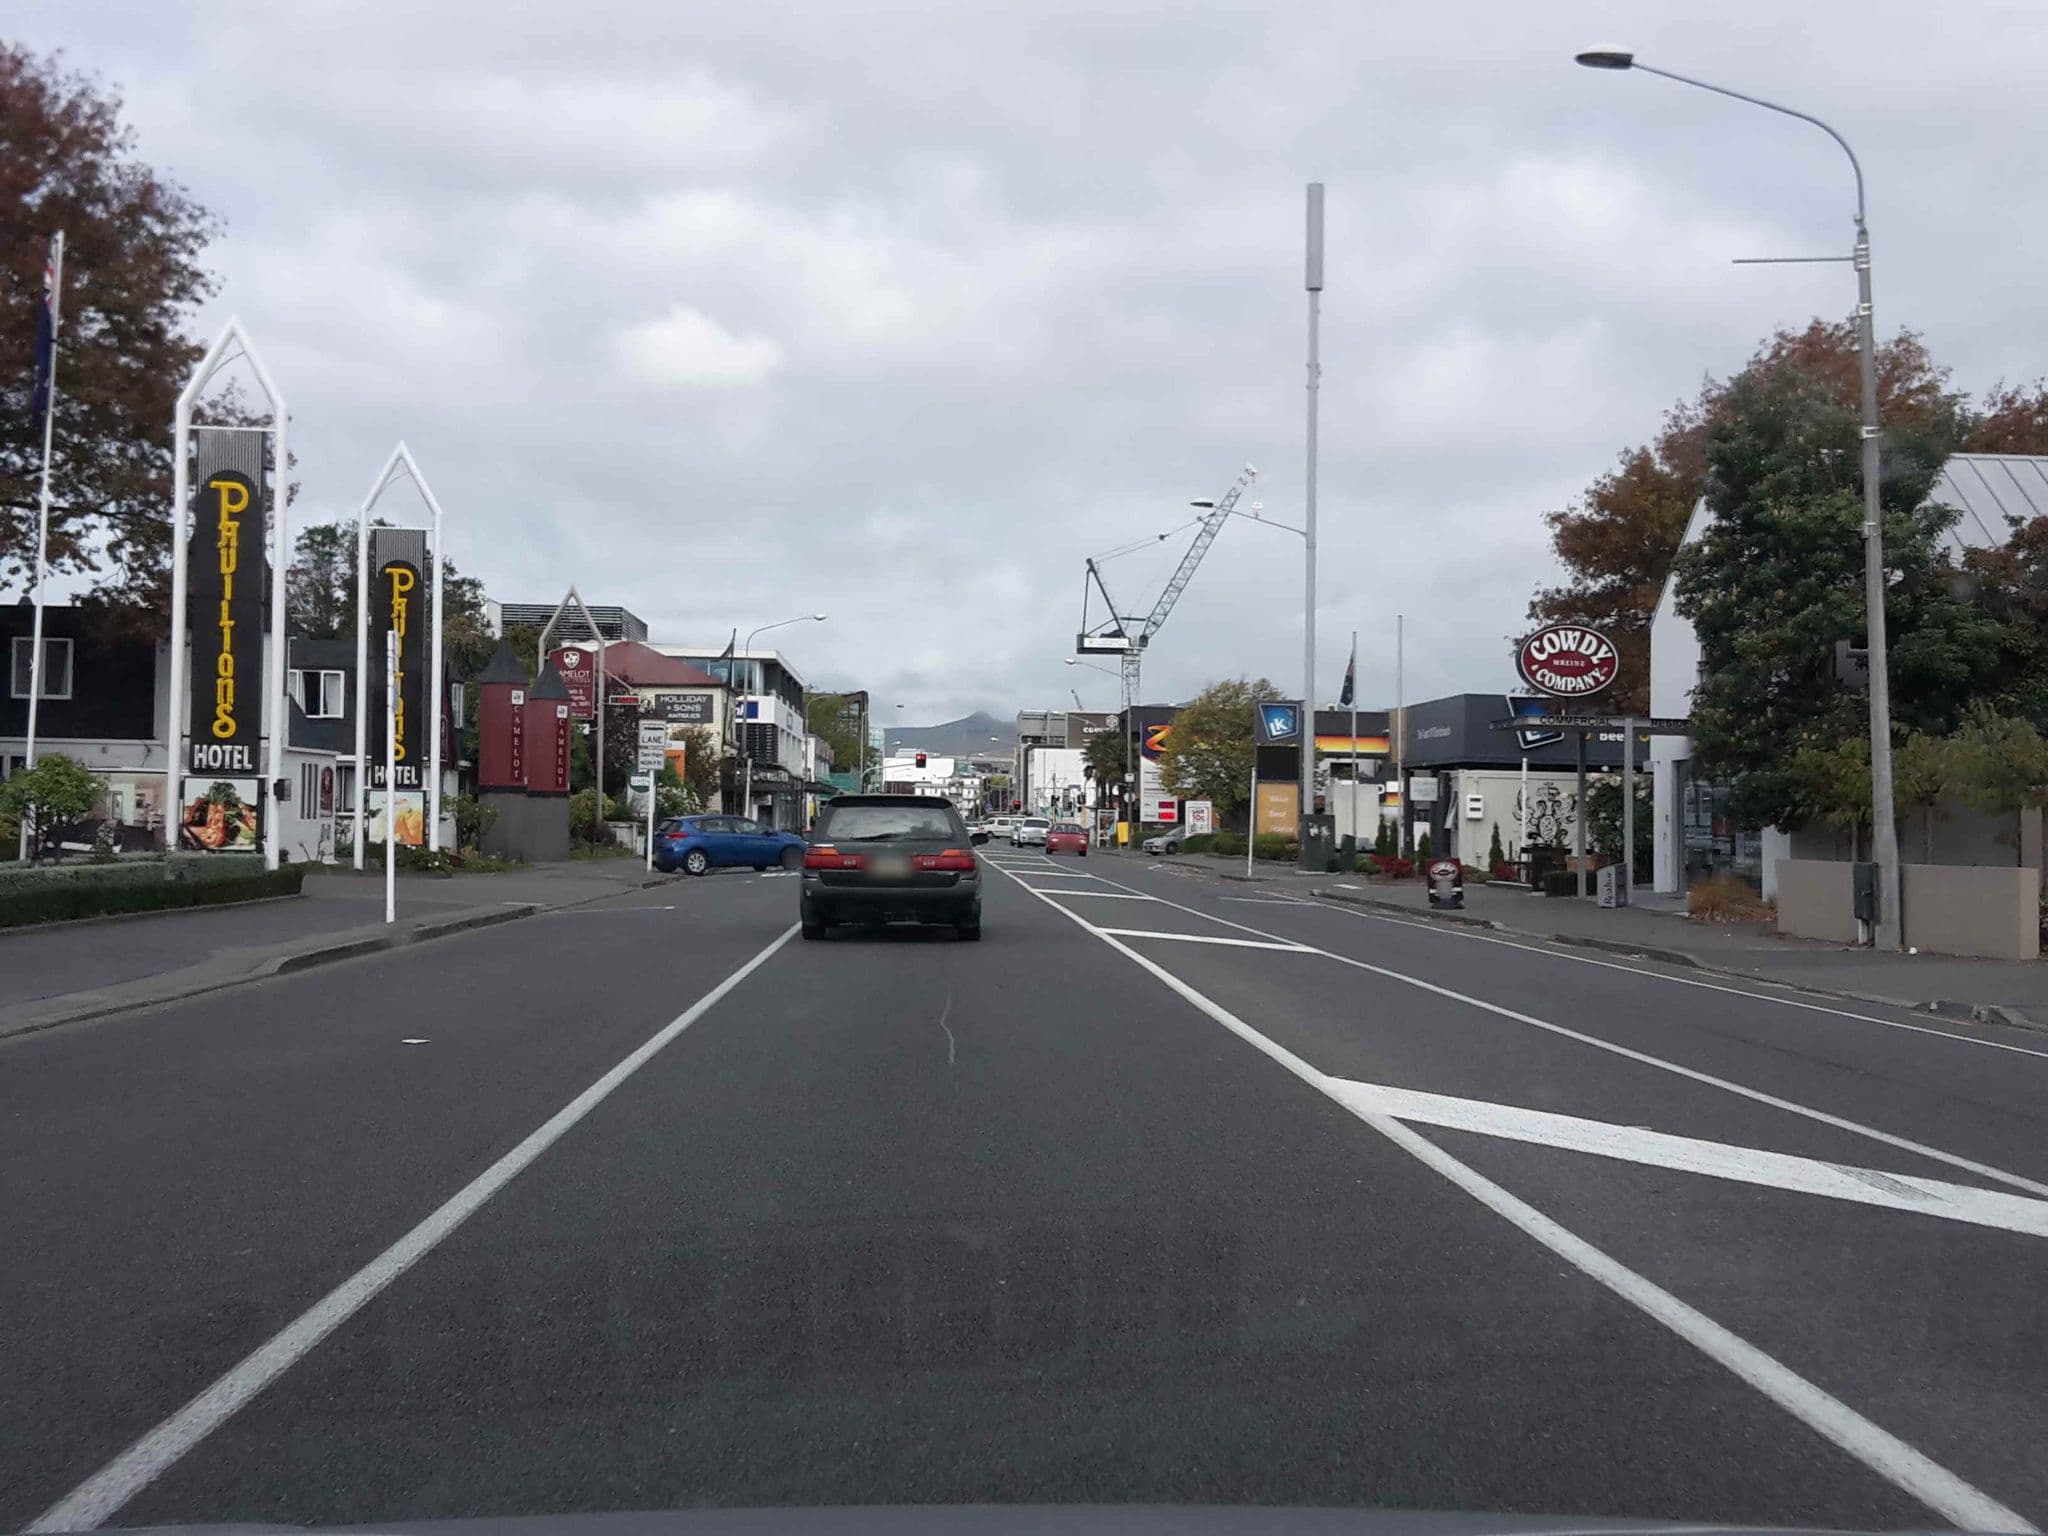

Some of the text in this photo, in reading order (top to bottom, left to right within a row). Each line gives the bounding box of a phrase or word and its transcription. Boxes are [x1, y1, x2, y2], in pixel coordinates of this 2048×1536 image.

[1530, 630, 1613, 664] COWDY
[559, 670, 591, 678] AMELOT
[1536, 667, 1605, 691] COMPANY
[660, 695, 707, 703] HOLLIDAY
[1540, 715, 1692, 729] COMMERCIAL RESIDE
[513, 705, 521, 778] CAMELOT
[641, 736, 662, 744] LANE
[193, 743, 252, 770] HOTEL
[374, 766, 419, 785] HTEL
